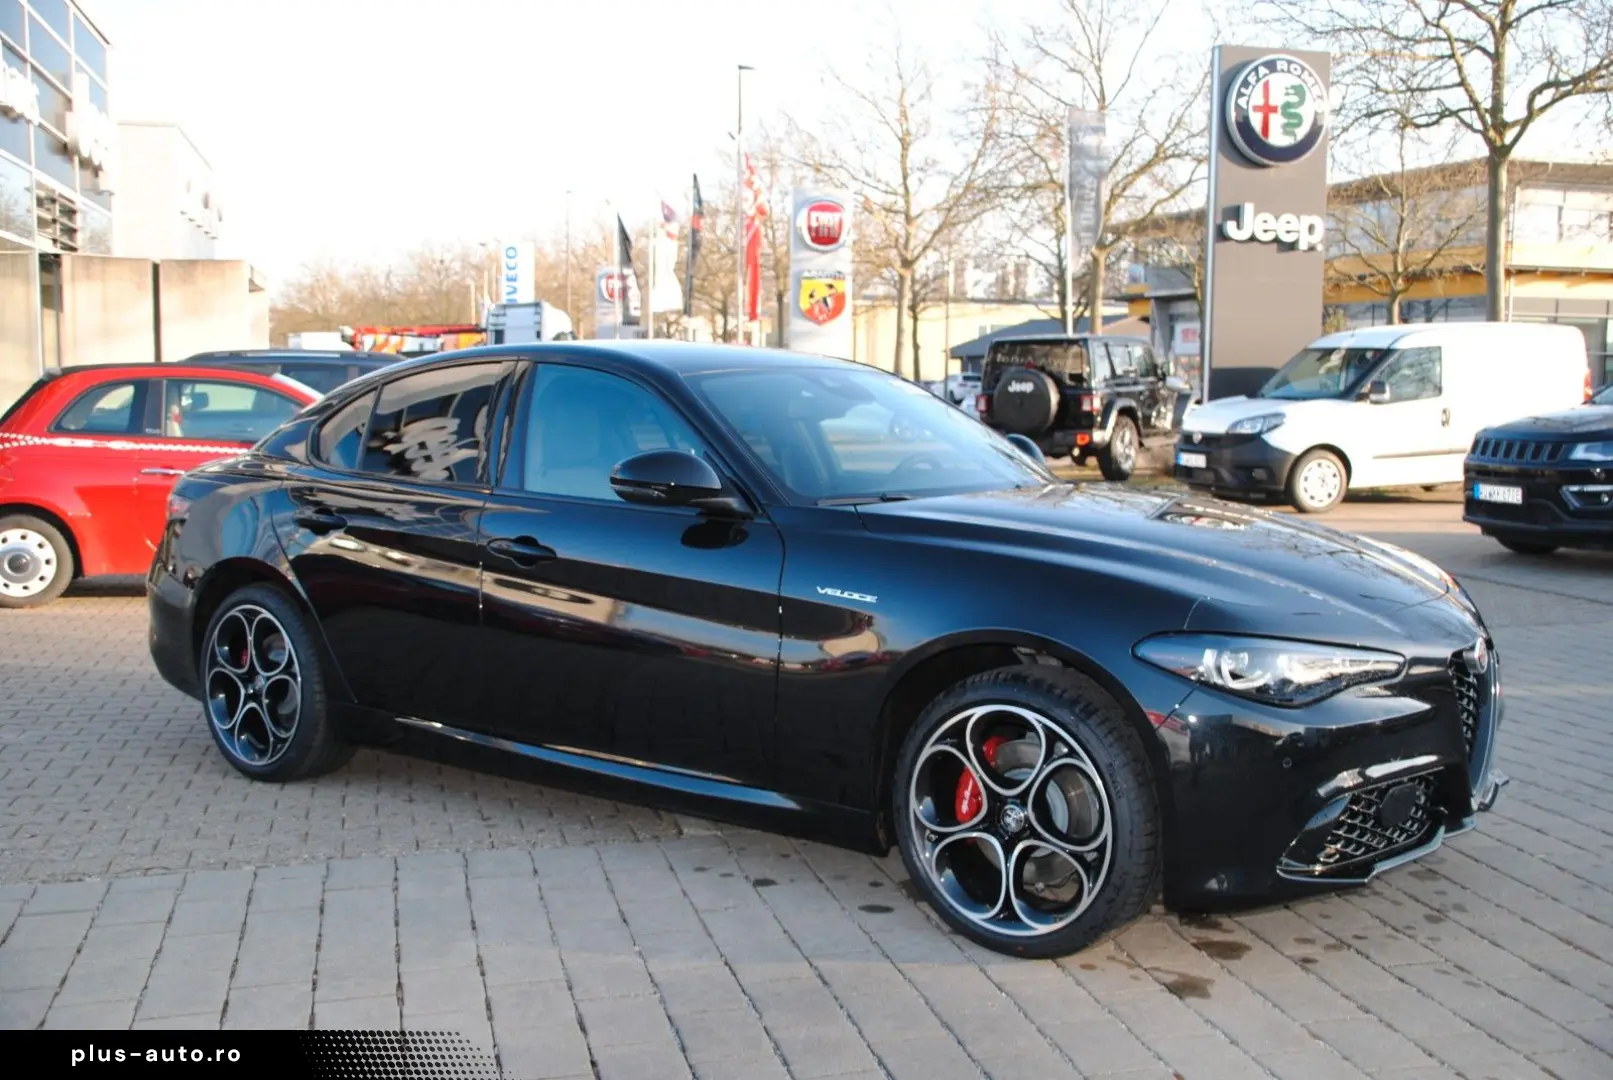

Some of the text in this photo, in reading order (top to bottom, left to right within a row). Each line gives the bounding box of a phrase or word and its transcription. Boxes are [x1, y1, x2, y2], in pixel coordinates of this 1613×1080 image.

[1237, 64, 1271, 110] ALFA
[1225, 202, 1325, 251] Jeep
[505, 246, 518, 304] IVECO
[1007, 380, 1034, 393] Jeep
[816, 586, 878, 603] VELOCE
